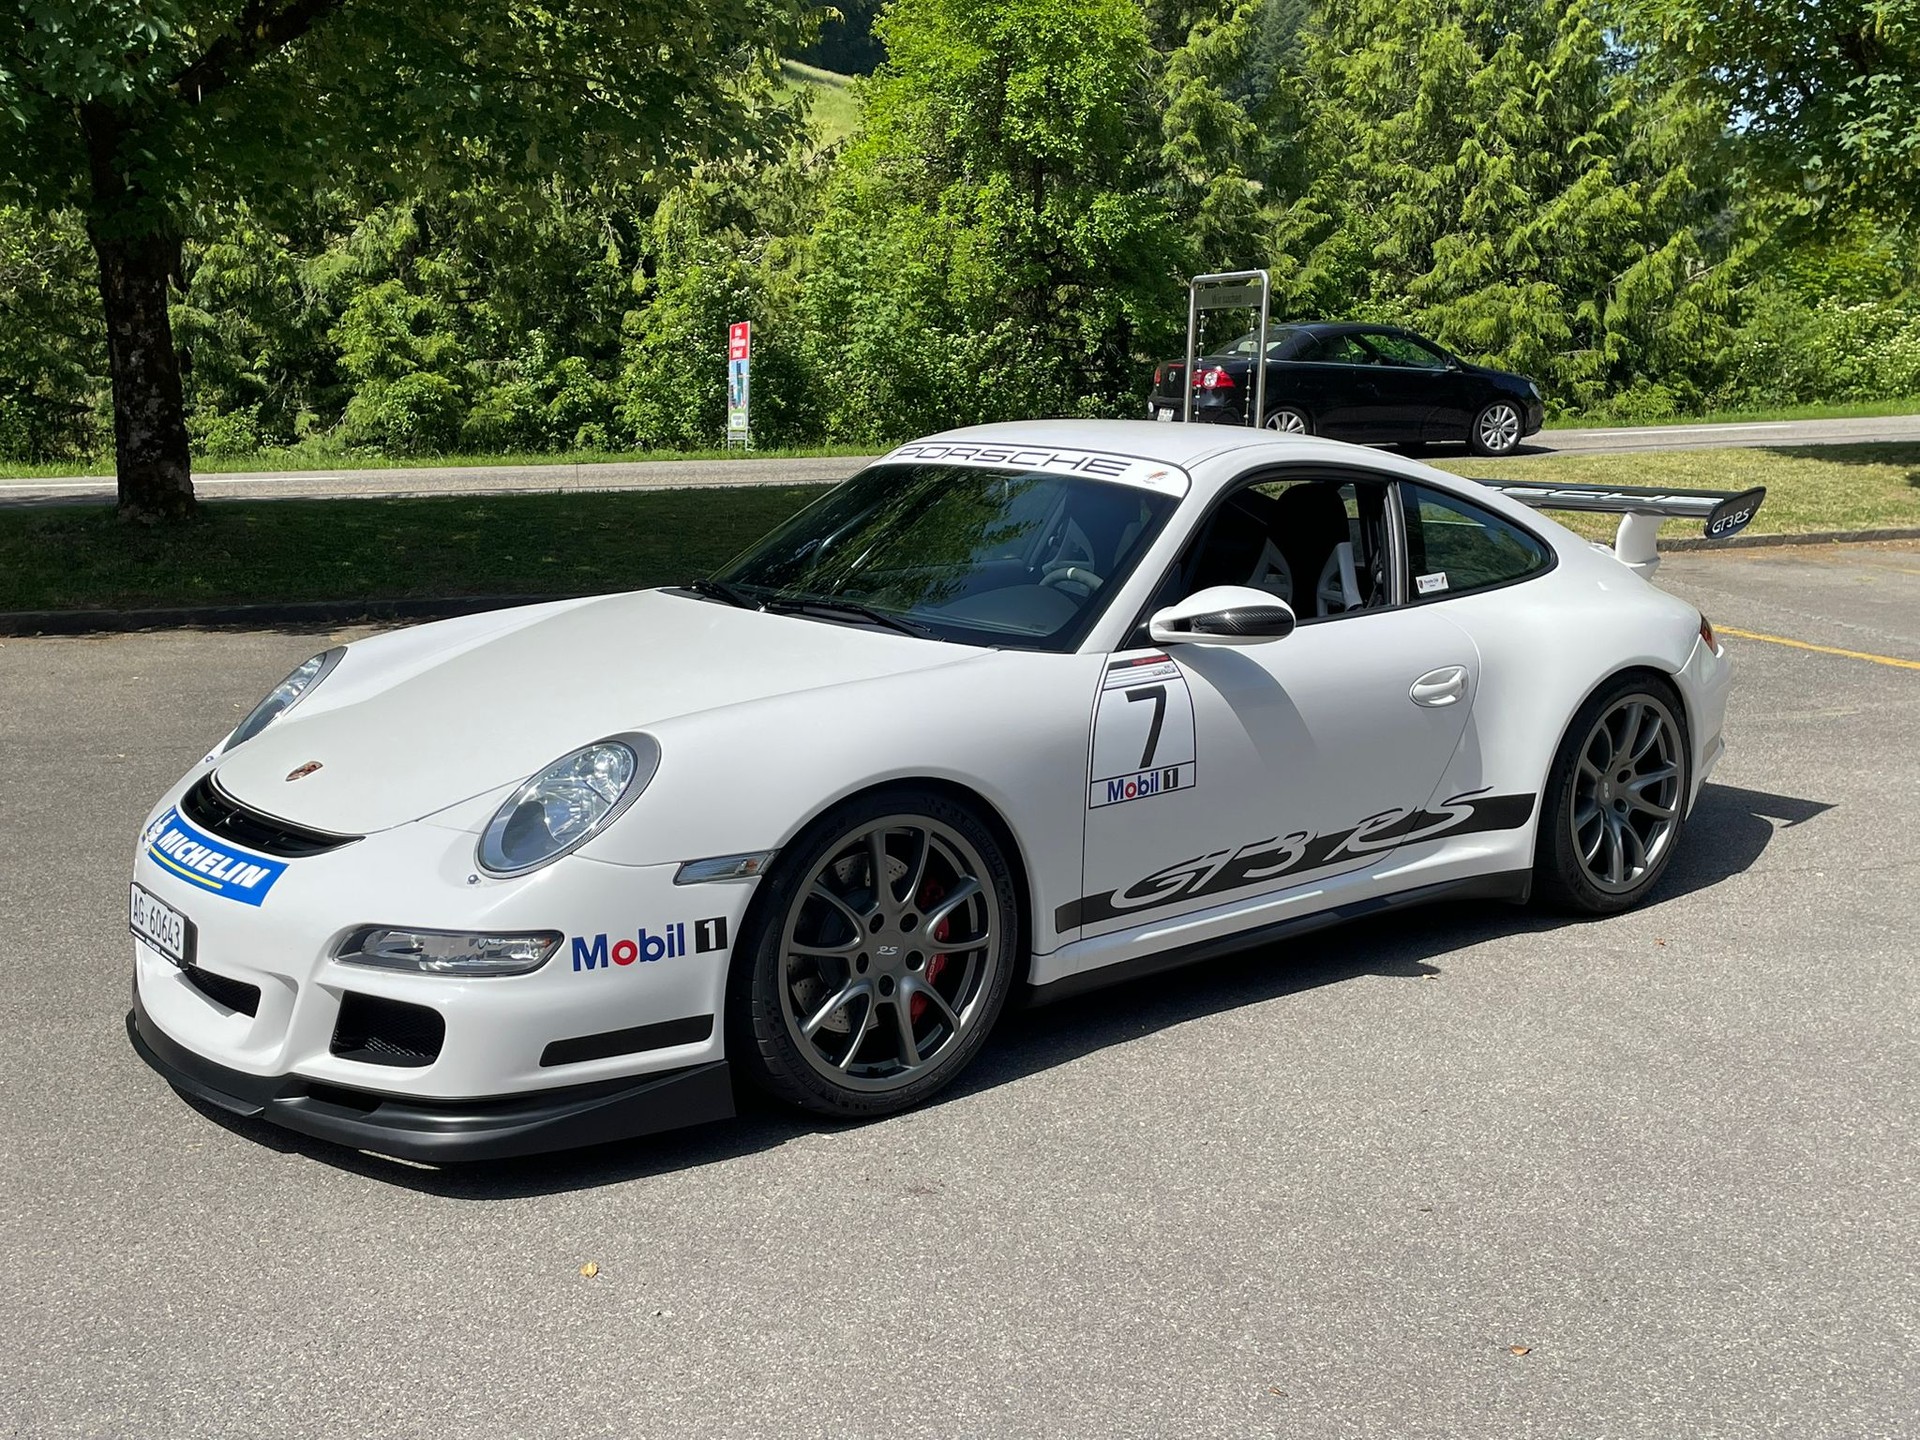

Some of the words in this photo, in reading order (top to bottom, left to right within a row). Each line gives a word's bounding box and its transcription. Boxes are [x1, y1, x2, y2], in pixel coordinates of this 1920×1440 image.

[889, 446, 1132, 477] PORSCHE
[1125, 684, 1167, 770] 7
[1107, 771, 1159, 802] Mobil
[157, 827, 271, 889] MICHELIN
[1110, 828, 1318, 908] GT3
[1322, 785, 1494, 862] RS
[571, 922, 686, 972] Mobil
